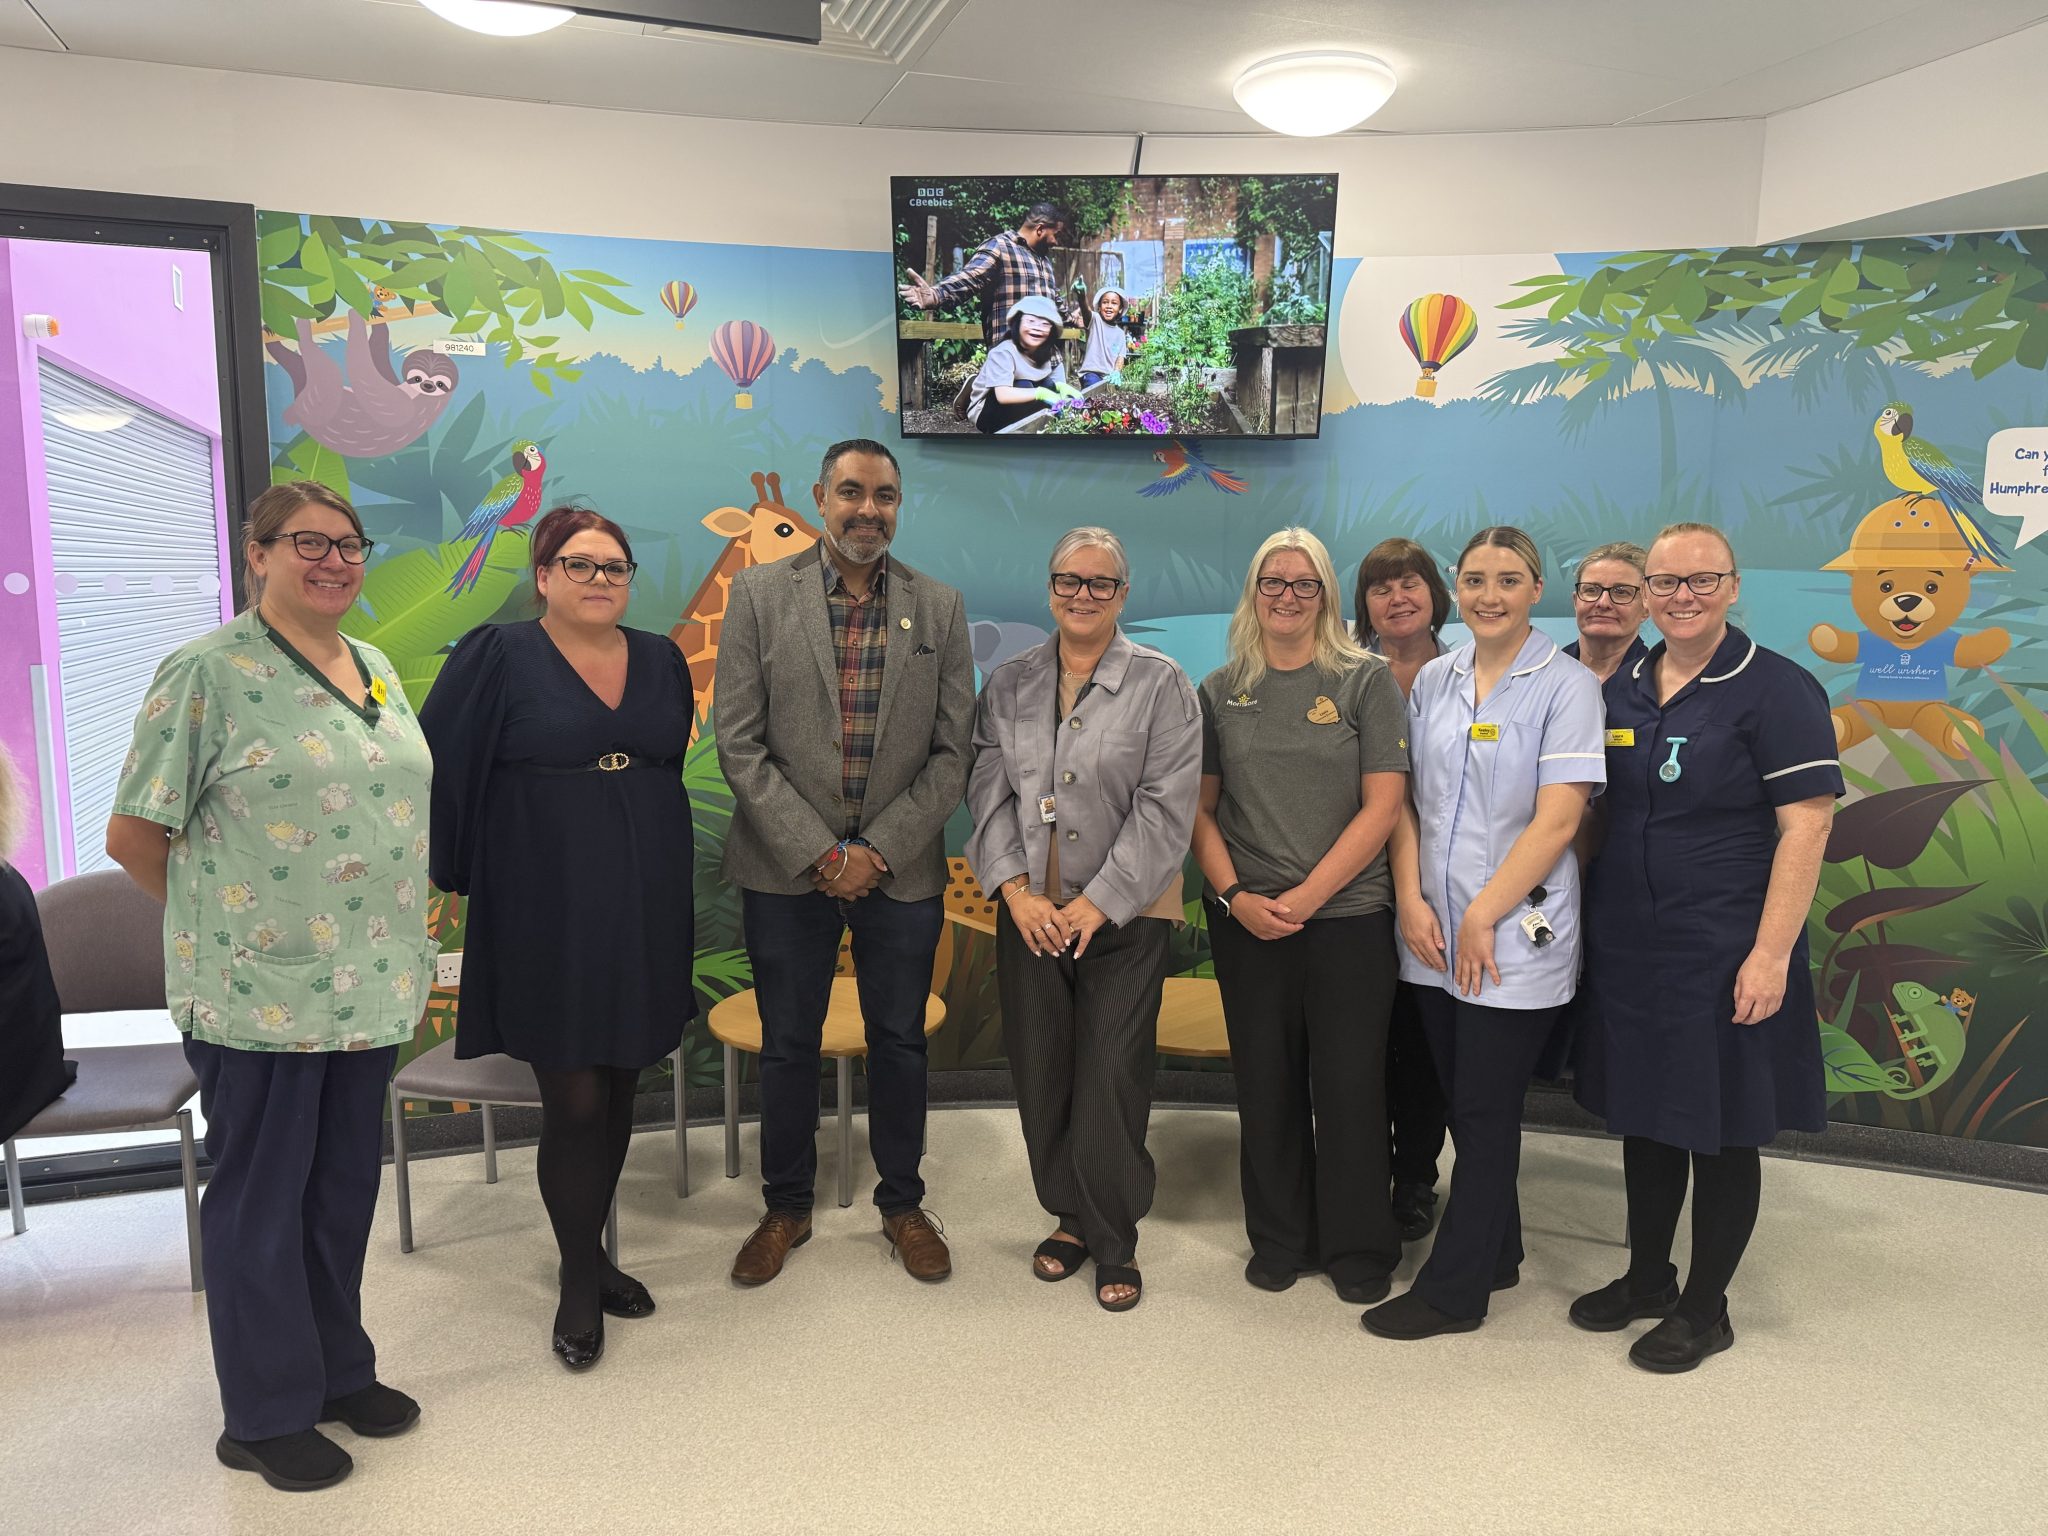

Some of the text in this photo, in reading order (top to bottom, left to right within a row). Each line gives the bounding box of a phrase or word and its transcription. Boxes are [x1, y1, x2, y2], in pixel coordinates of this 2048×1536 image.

[917, 187, 944, 197] BBC
[909, 197, 953, 207] CBeebies
[444, 343, 475, 352] 981240
[2014, 447, 2040, 460] Can
[1869, 663, 1939, 676] well wishers
